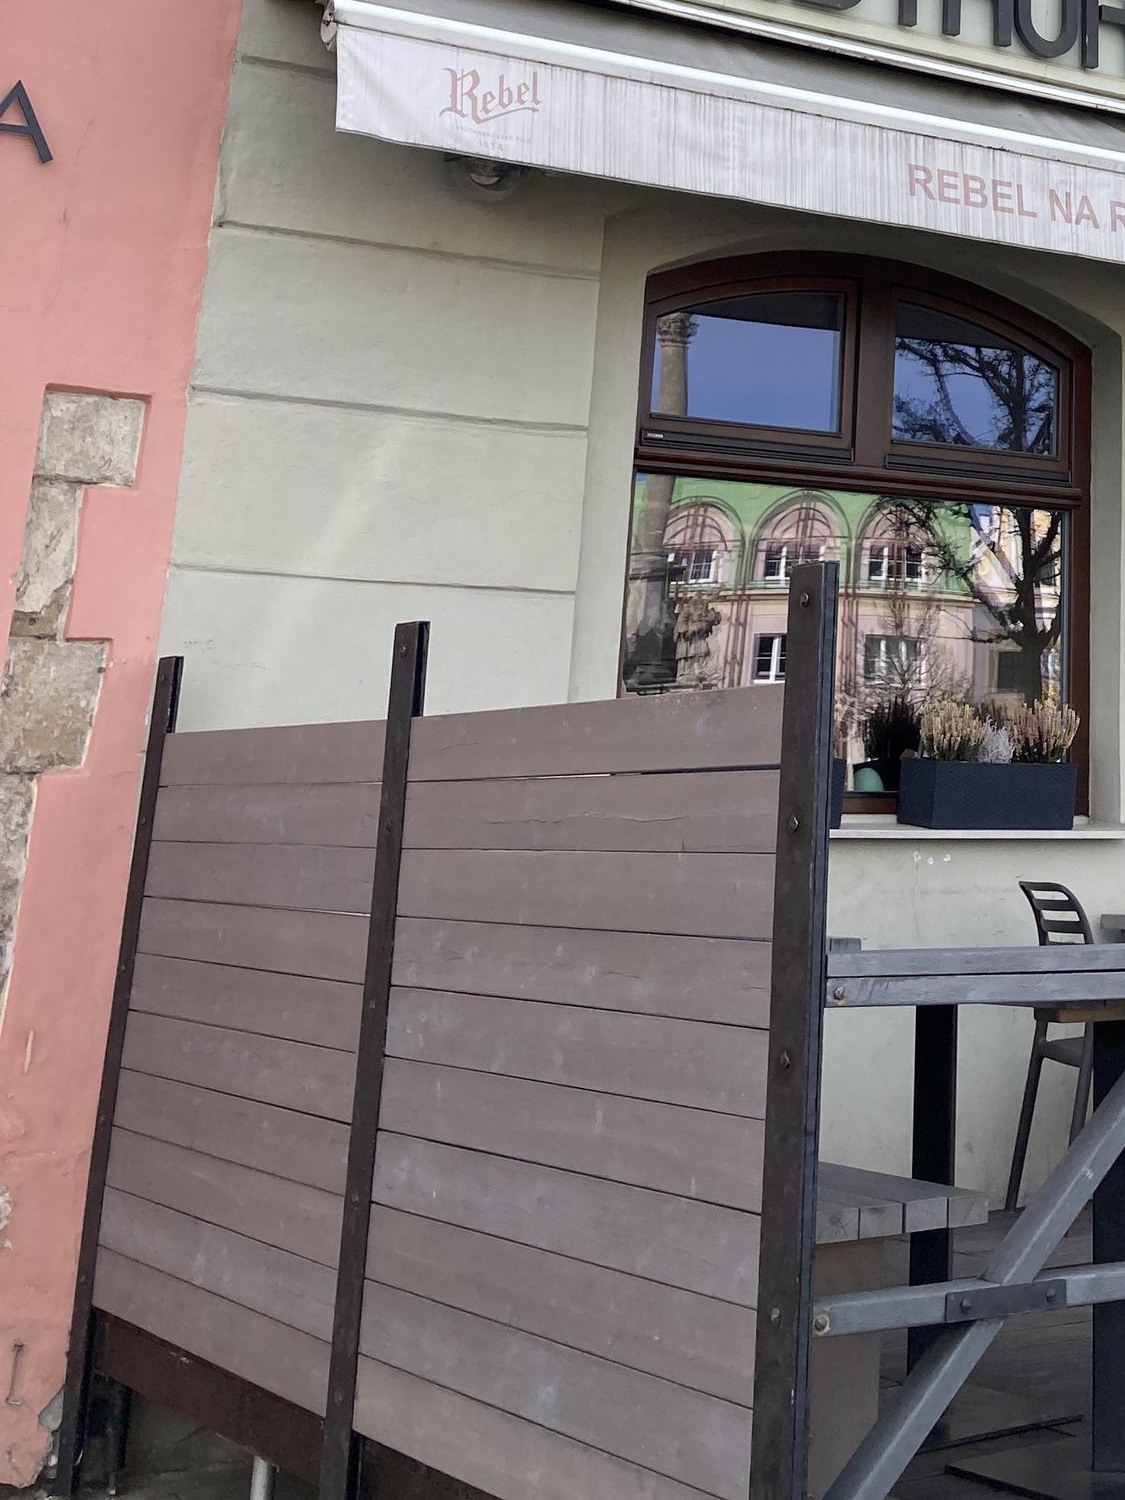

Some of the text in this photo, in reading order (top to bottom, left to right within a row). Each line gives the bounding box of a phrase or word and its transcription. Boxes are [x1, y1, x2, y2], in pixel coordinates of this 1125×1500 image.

[439, 67, 543, 125] Rebel
[907, 163, 1038, 219] REBEL
[1049, 188, 1100, 229] NA
